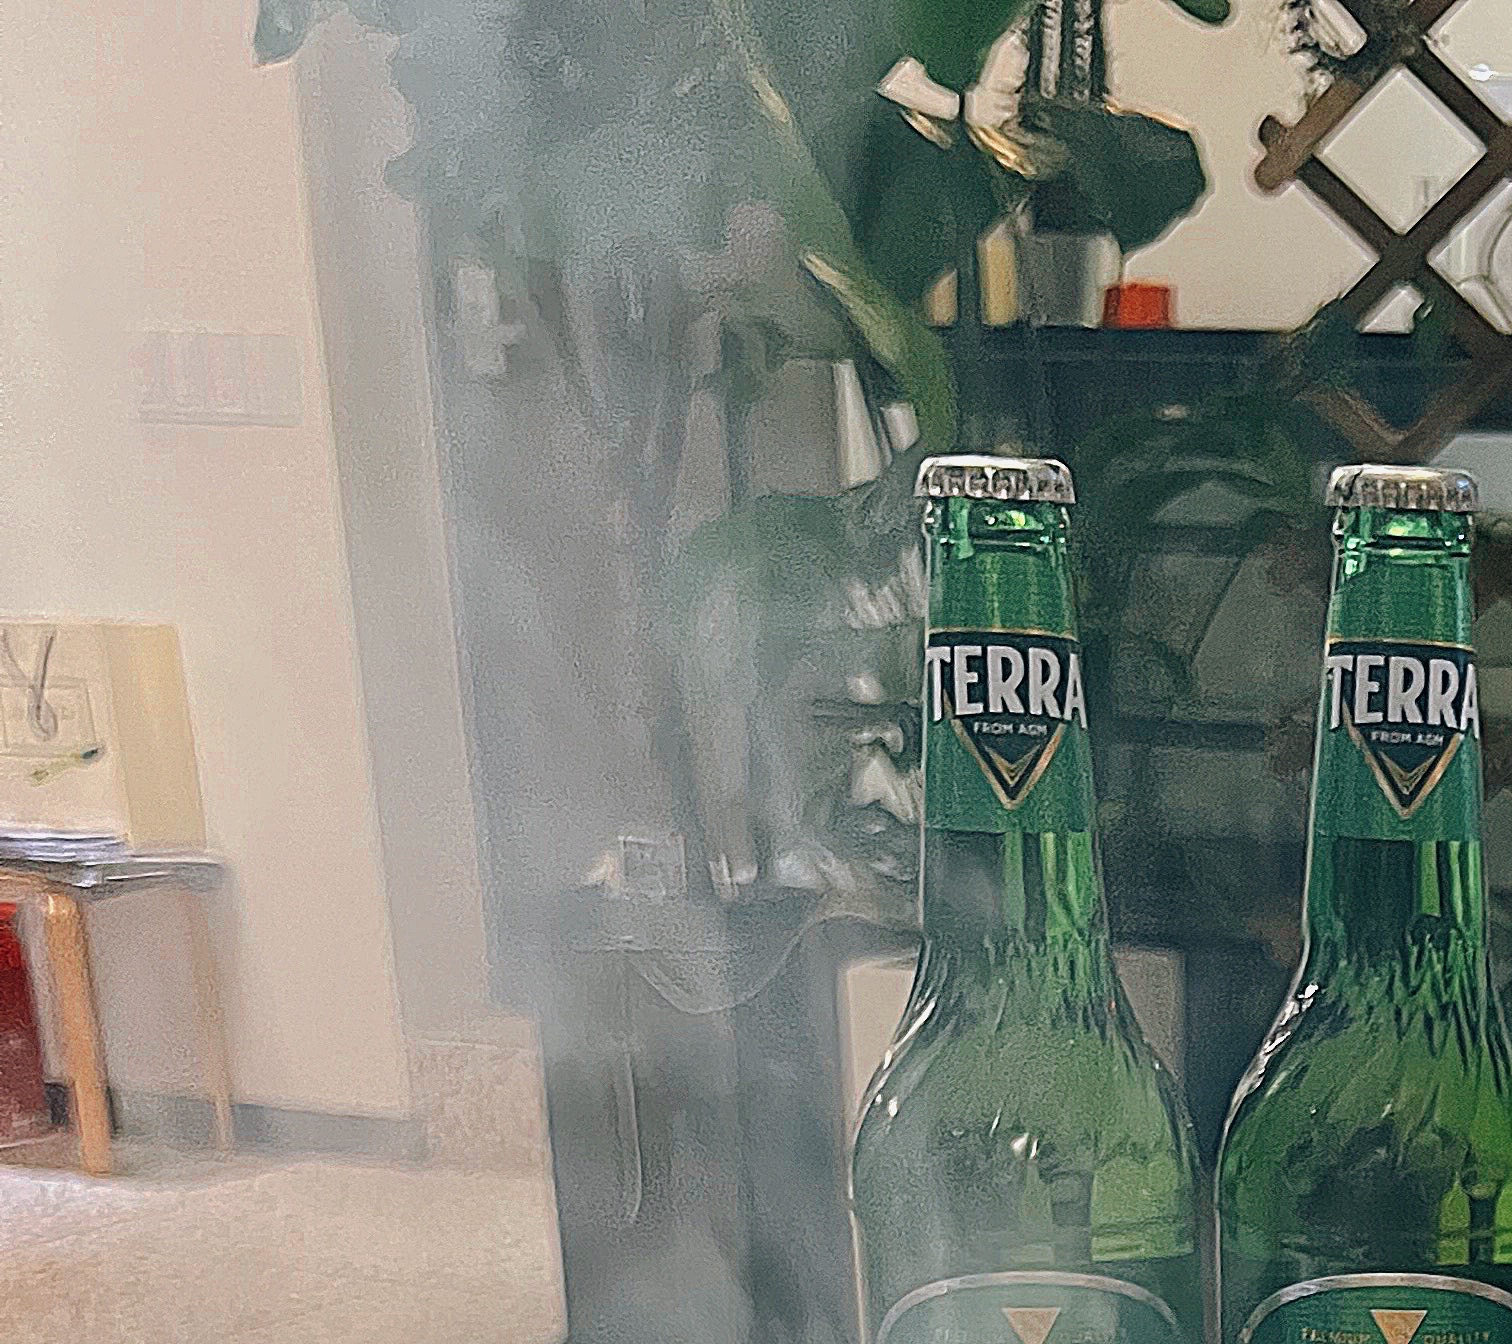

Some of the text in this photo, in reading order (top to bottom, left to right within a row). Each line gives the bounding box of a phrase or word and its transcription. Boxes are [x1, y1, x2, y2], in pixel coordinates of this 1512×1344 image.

[925, 645, 1088, 730] TERRA
[1327, 655, 1480, 740] TERRA
[974, 721, 1047, 737] FROM AGM
[1371, 730, 1444, 747] FROM AGM
